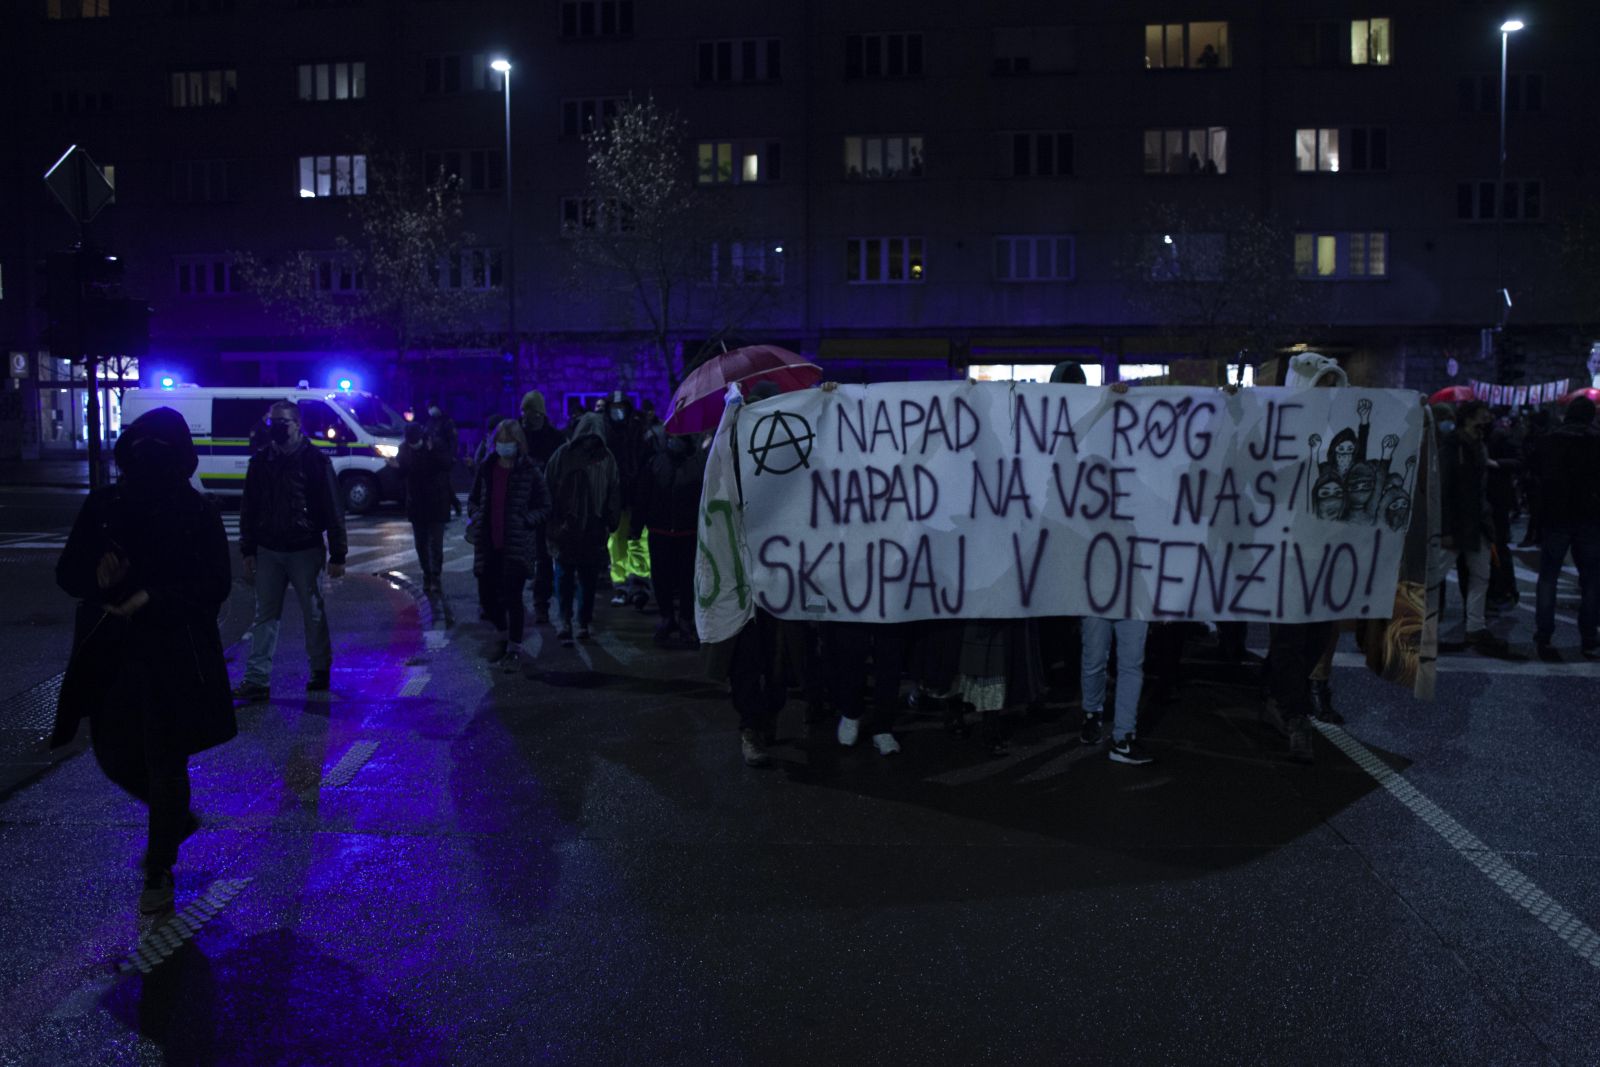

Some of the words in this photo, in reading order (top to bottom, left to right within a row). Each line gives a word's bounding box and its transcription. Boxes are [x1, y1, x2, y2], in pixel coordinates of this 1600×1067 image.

[837, 396, 980, 454] NAPAD
[1015, 394, 1079, 454] NA
[1249, 401, 1304, 461] JE
[810, 464, 939, 528] NAPAD
[970, 458, 1032, 519] NA
[1052, 461, 1136, 521] VSE
[758, 534, 966, 618] SKUPAJ
[1013, 528, 1049, 607] V
